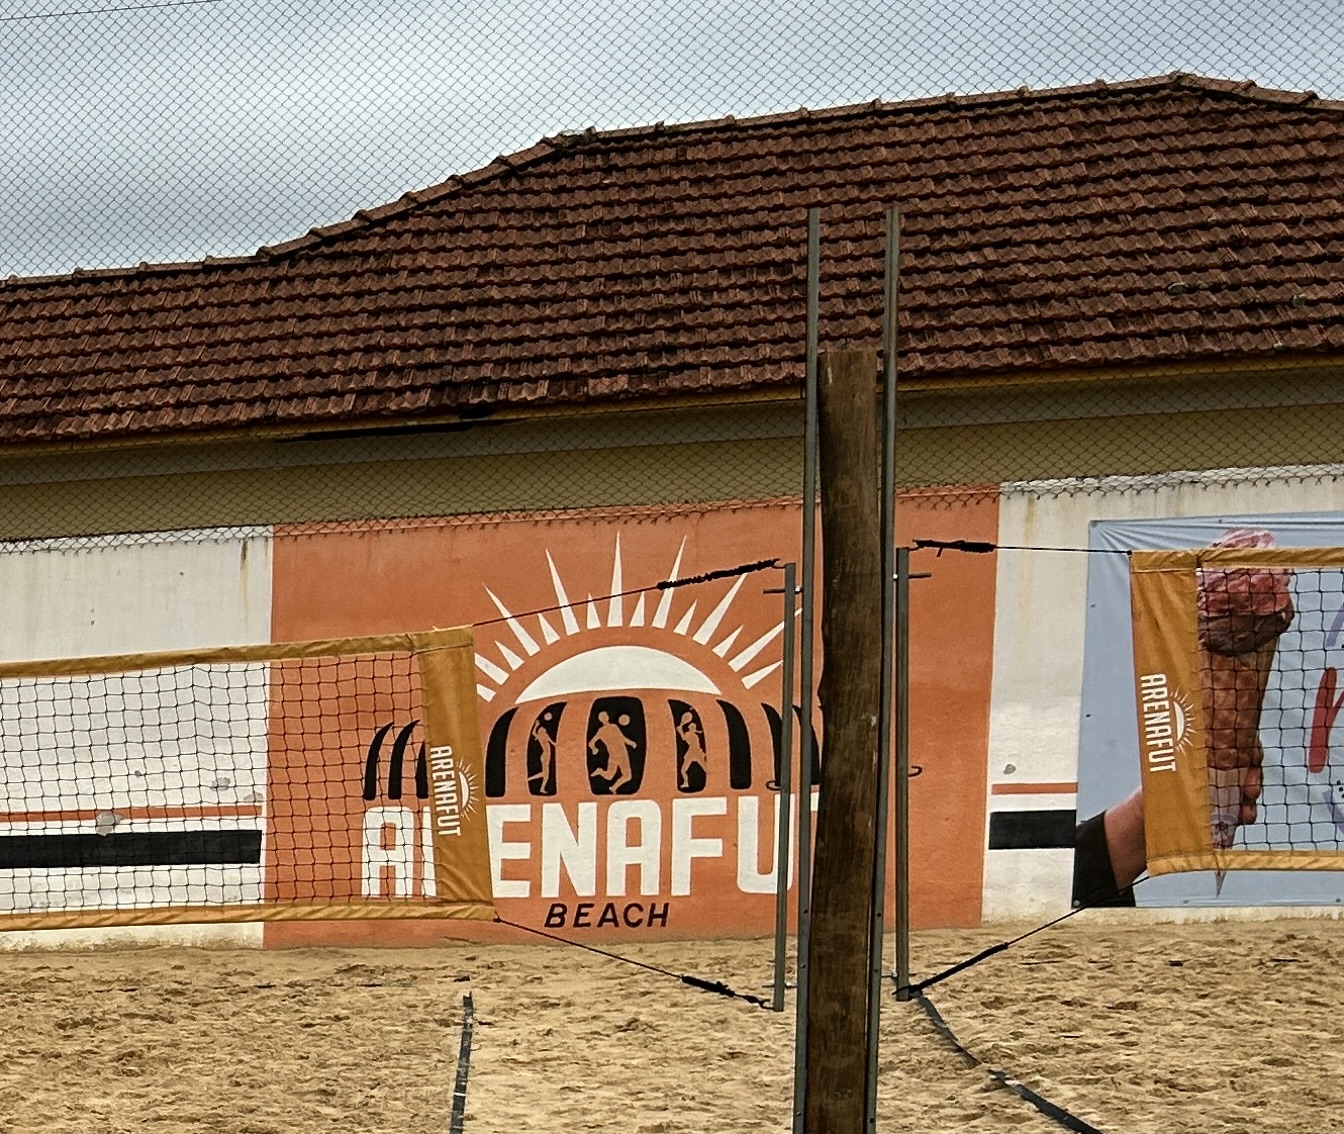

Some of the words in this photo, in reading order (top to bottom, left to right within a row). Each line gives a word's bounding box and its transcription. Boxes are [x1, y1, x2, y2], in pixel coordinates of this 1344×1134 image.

[1141, 673, 1176, 773] ARENAFUT
[430, 745, 461, 836] ARENAFUT
[362, 792, 819, 898] AENAFU
[544, 903, 669, 928] BEACH
